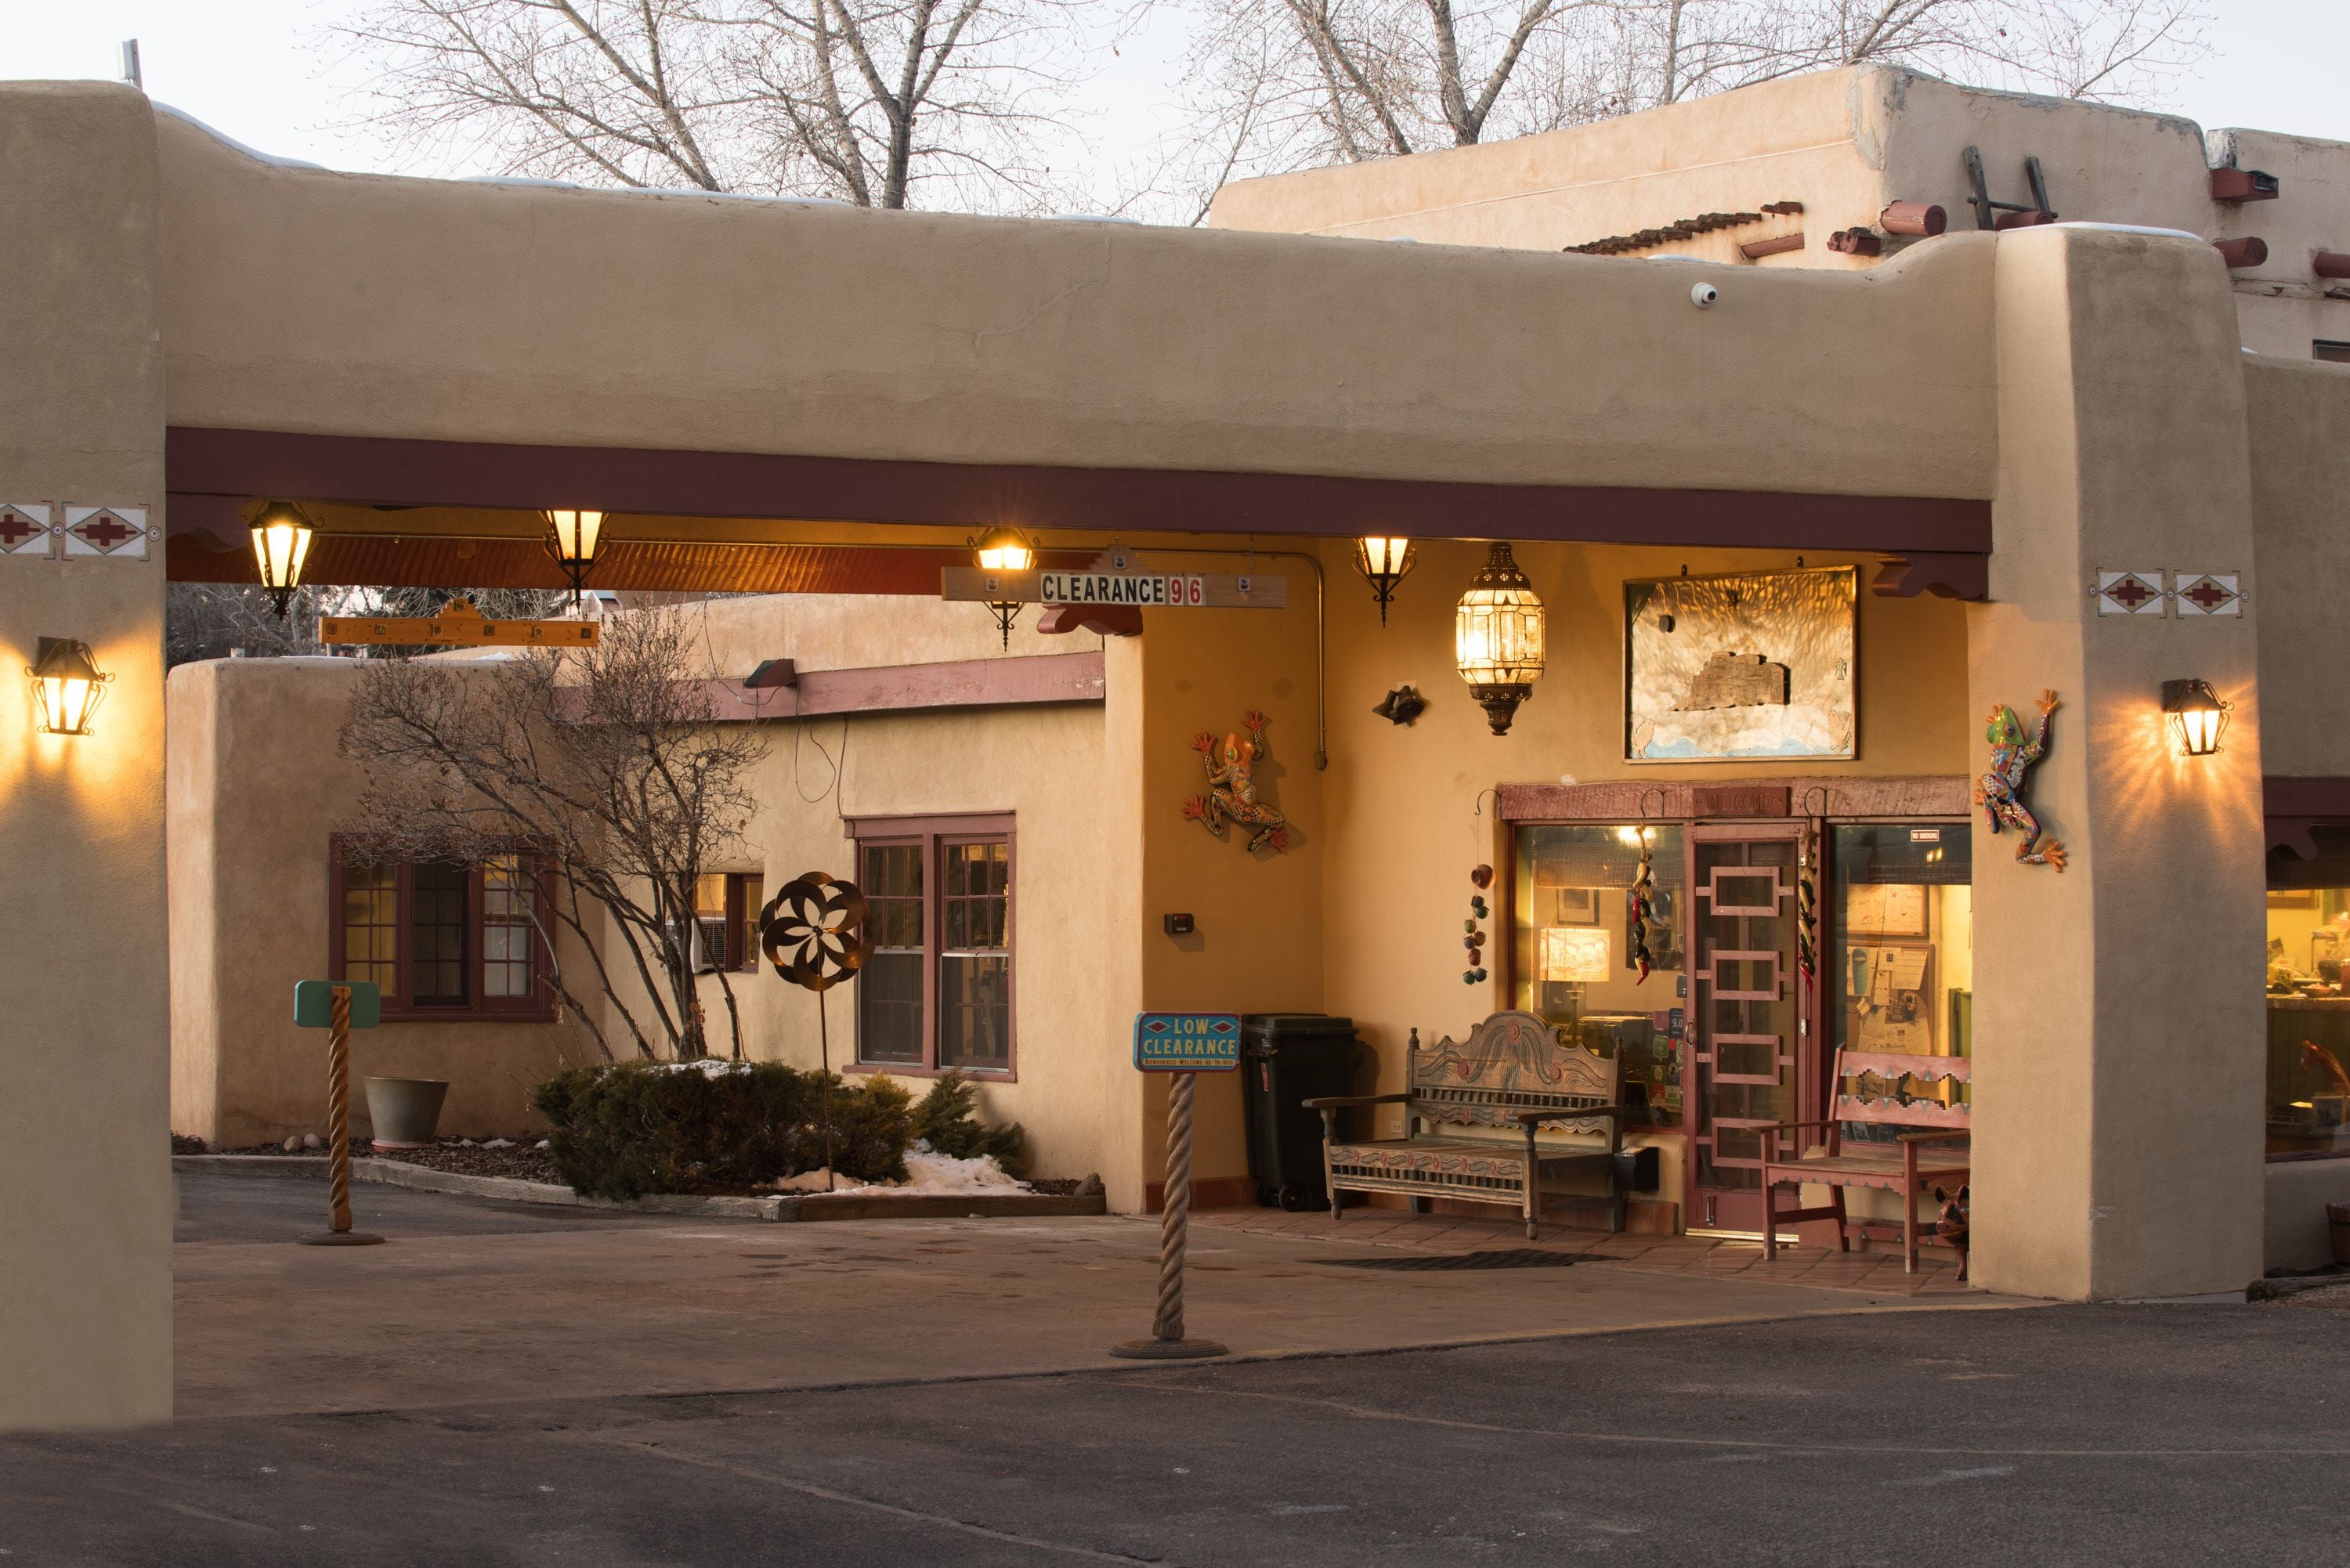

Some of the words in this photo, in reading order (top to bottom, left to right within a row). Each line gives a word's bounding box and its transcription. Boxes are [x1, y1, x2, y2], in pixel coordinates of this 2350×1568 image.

[1042, 575, 1163, 603] CLEARANCE
[1706, 793, 1771, 810] WELCOME
[1174, 1019, 1209, 1035] LOW
[1672, 1018, 1683, 1028] 9.0
[1144, 1039, 1236, 1055] CLEARANCE
